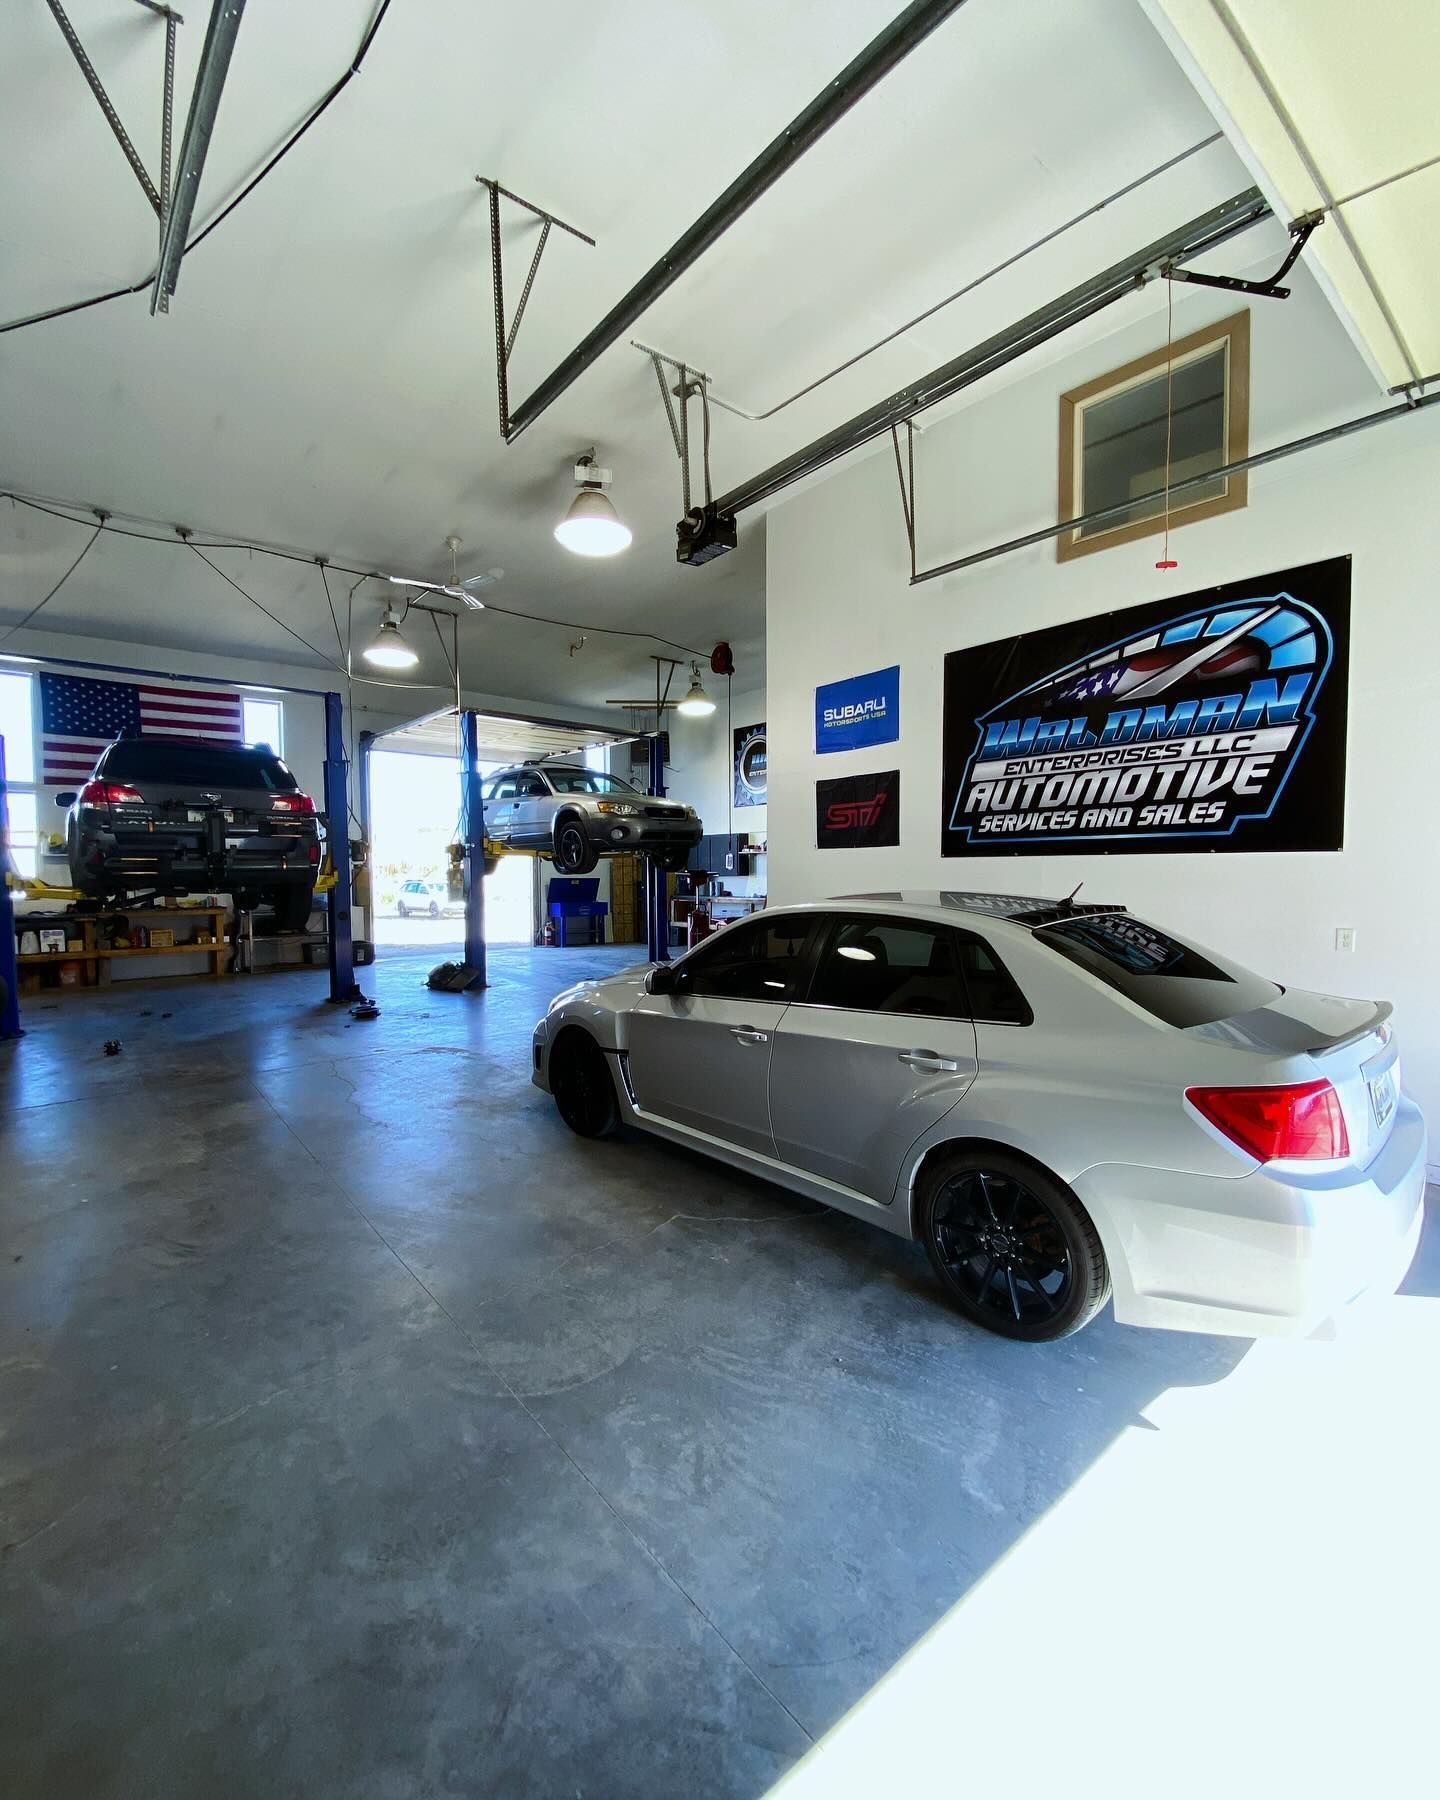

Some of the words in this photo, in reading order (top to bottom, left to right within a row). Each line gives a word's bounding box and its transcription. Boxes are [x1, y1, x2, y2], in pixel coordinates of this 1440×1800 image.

[823, 696, 886, 721] SUBARU
[823, 713, 870, 728] MOTORSPORTS
[870, 710, 886, 718] USA
[977, 672, 1314, 760] WALDMAN
[1003, 743, 1183, 776] ENTERPRISES
[1190, 734, 1257, 756] LLC
[964, 754, 1276, 812] AUTOMOTIVE
[977, 810, 1076, 833] SERVICES
[1080, 806, 1132, 829] AND
[1139, 801, 1227, 825] SALES
